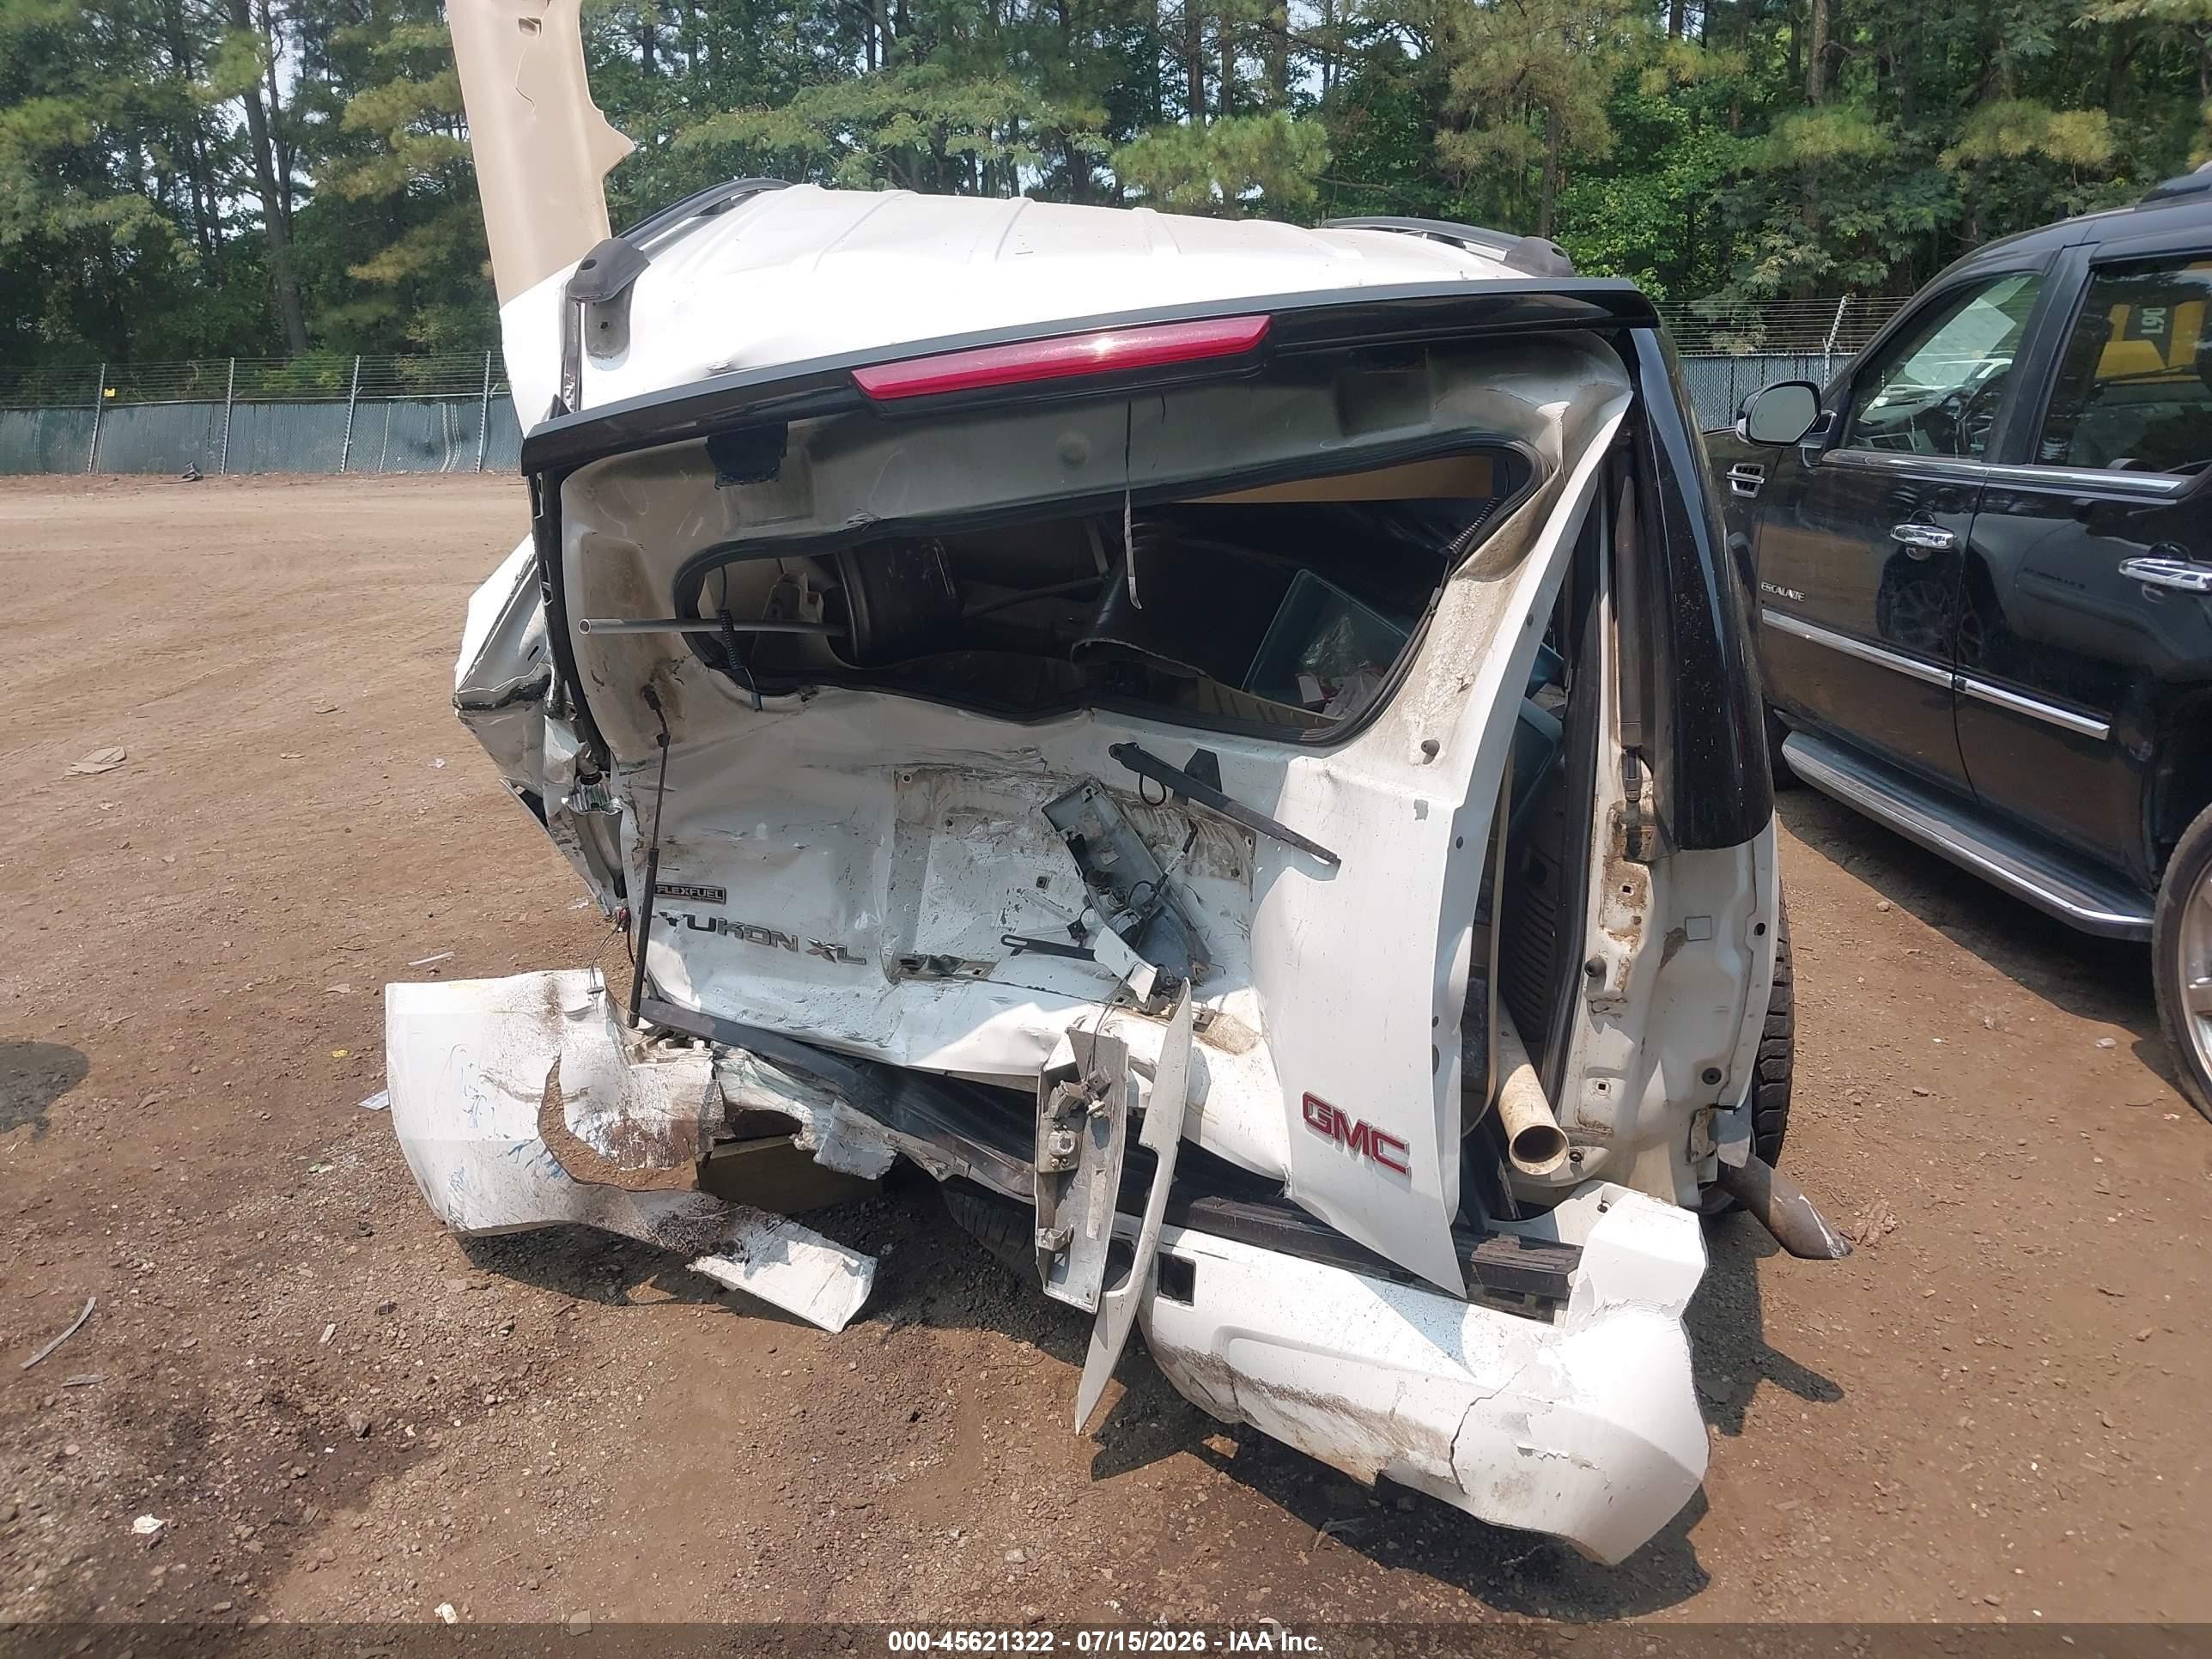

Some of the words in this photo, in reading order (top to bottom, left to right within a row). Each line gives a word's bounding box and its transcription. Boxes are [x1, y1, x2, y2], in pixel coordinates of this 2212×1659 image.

[1761, 580, 1805, 602] ESCALADE
[659, 911, 799, 952] YUKON
[805, 935, 867, 964] XL
[1302, 1091, 1412, 1177] GMC
